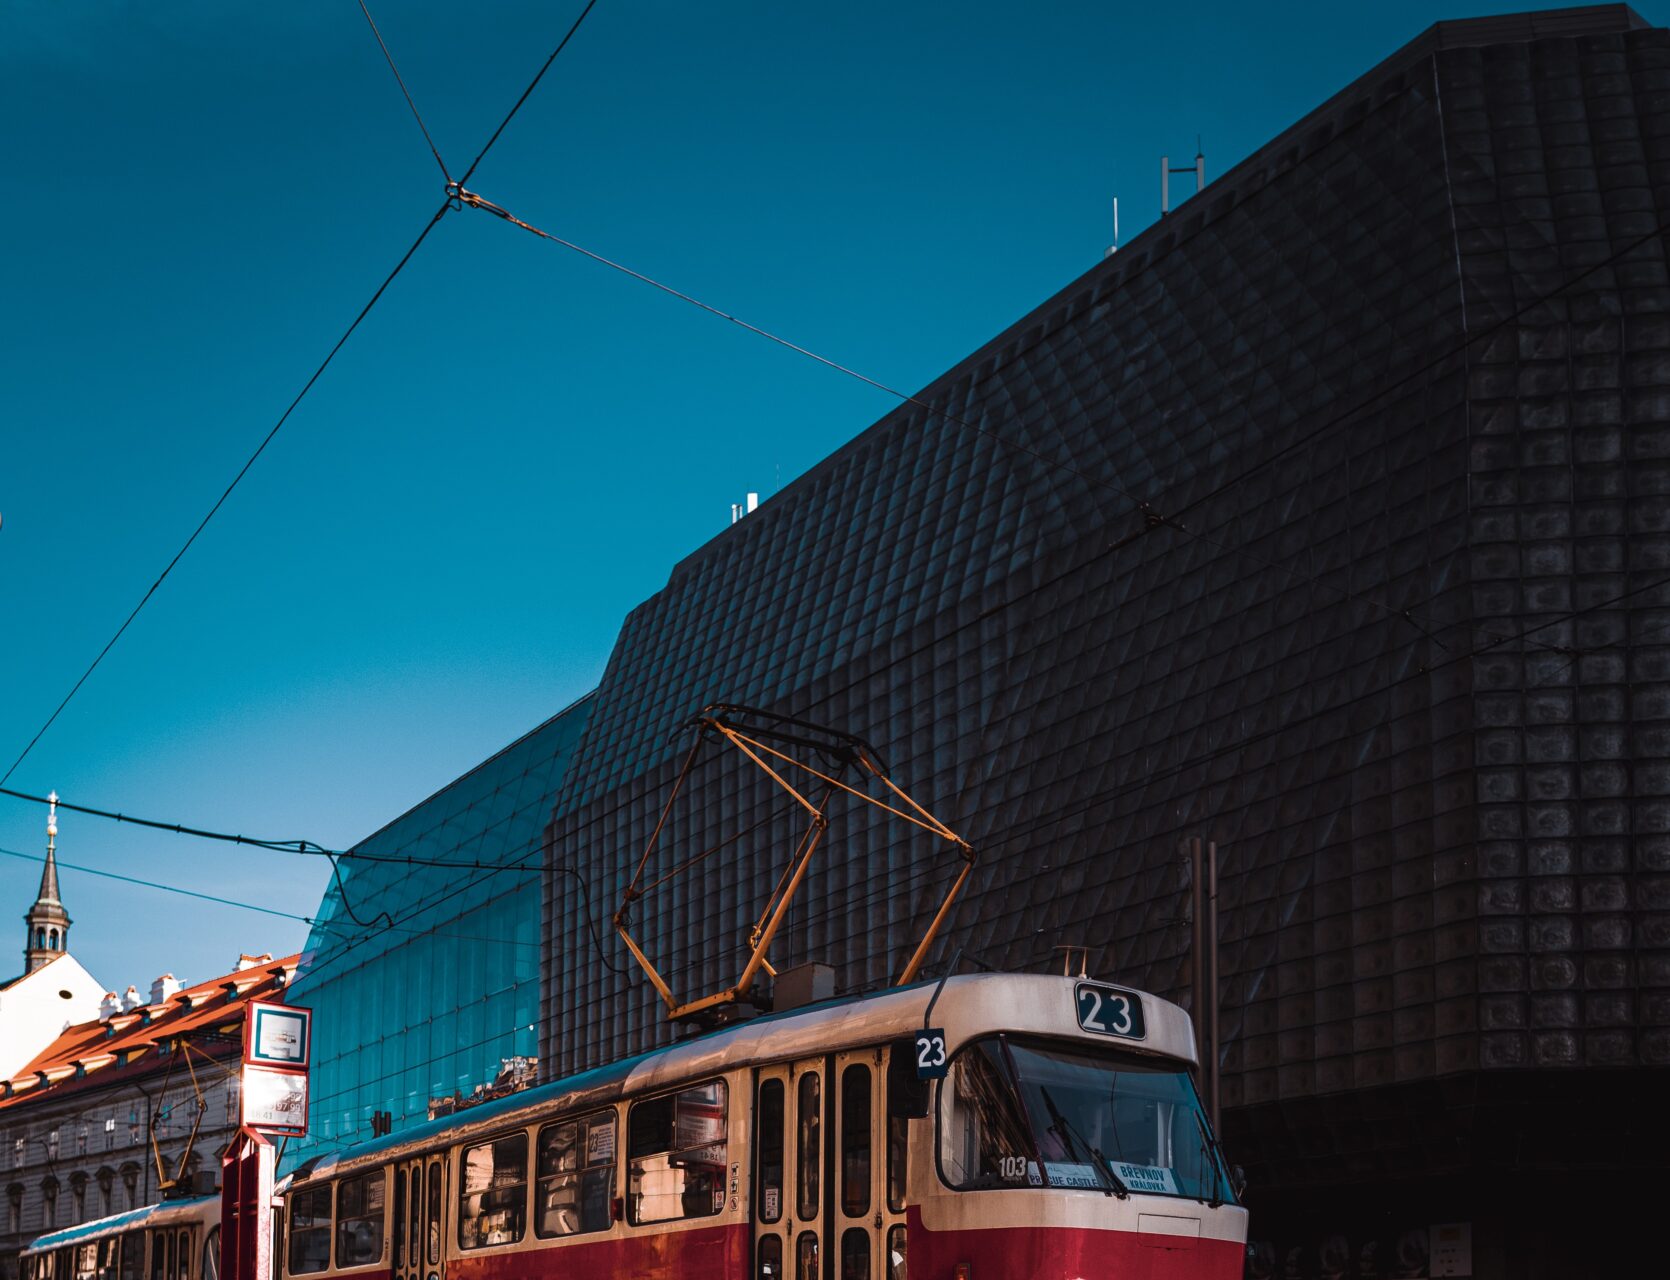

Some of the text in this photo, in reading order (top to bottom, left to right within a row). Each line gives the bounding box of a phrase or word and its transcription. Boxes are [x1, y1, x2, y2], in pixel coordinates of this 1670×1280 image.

[1080, 988, 1132, 1034] 23
[917, 1036, 946, 1067] 23
[277, 1103, 301, 1112] 97 99
[589, 1133, 599, 1152] 23
[999, 1156, 1026, 1177] 103
[1120, 1164, 1165, 1181] BŘEVNOV
[1029, 1174, 1064, 1186] PRGUE
[1066, 1177, 1100, 1187] CASTLE
[1129, 1179, 1167, 1192] KRÁLOVKA
